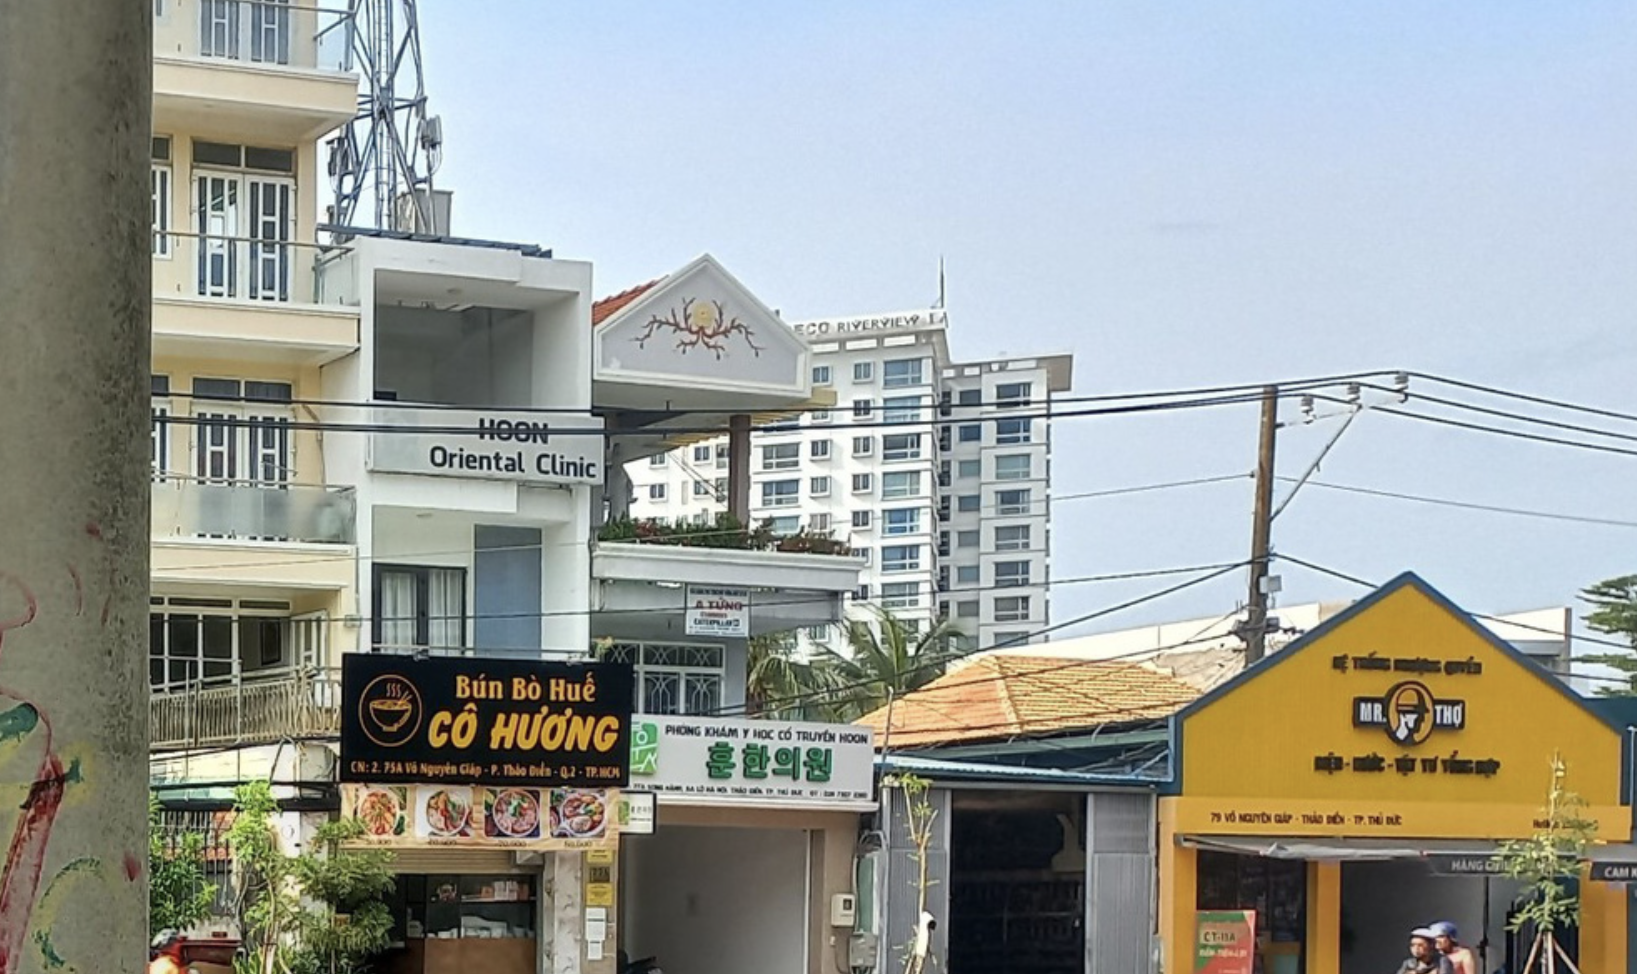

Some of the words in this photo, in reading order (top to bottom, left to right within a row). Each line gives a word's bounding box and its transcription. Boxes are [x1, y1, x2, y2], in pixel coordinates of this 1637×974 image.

[837, 314, 920, 333] RIVERVIEW
[479, 418, 549, 445] HOON
[430, 445, 525, 474] Oriental
[536, 453, 597, 478] Clinic
[456, 672, 503, 700] Bún
[513, 674, 541, 701] Bò
[550, 671, 596, 702] Huế
[428, 702, 479, 749] CÔ
[489, 705, 620, 751] HƯƠNG
[1359, 702, 1387, 723] MR.
[1434, 703, 1464, 728] THỢ
[665, 723, 701, 737] PHÒNG
[704, 723, 739, 738] KHÁM
[742, 728, 750, 739] Y
[839, 732, 868, 744] HOON
[1605, 867, 1629, 879] CAM
